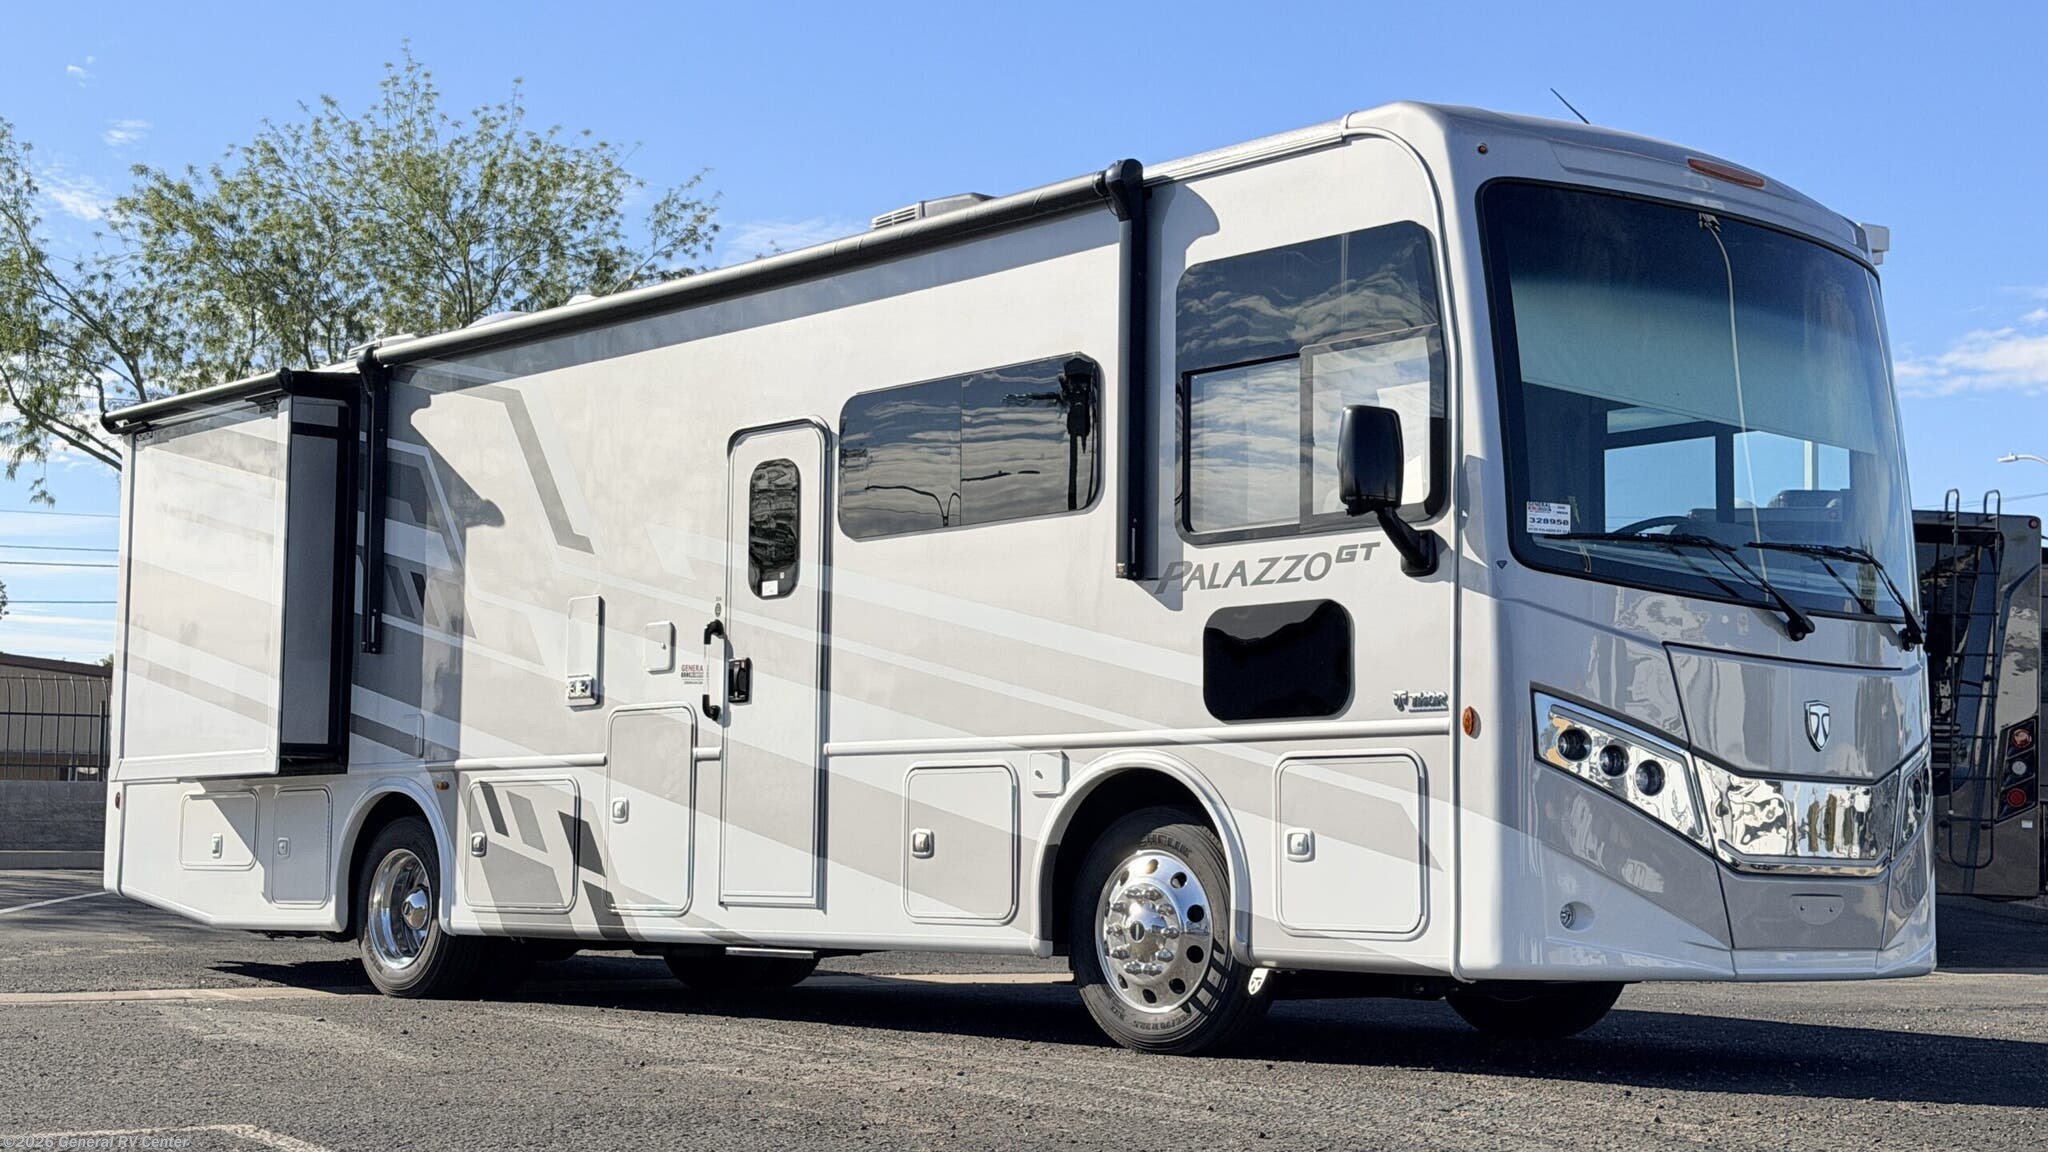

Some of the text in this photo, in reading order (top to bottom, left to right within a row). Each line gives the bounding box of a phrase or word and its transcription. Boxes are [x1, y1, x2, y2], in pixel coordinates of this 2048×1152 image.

[1154, 542, 1381, 594] PALAZZO GT
[681, 664, 704, 672] GENERA
